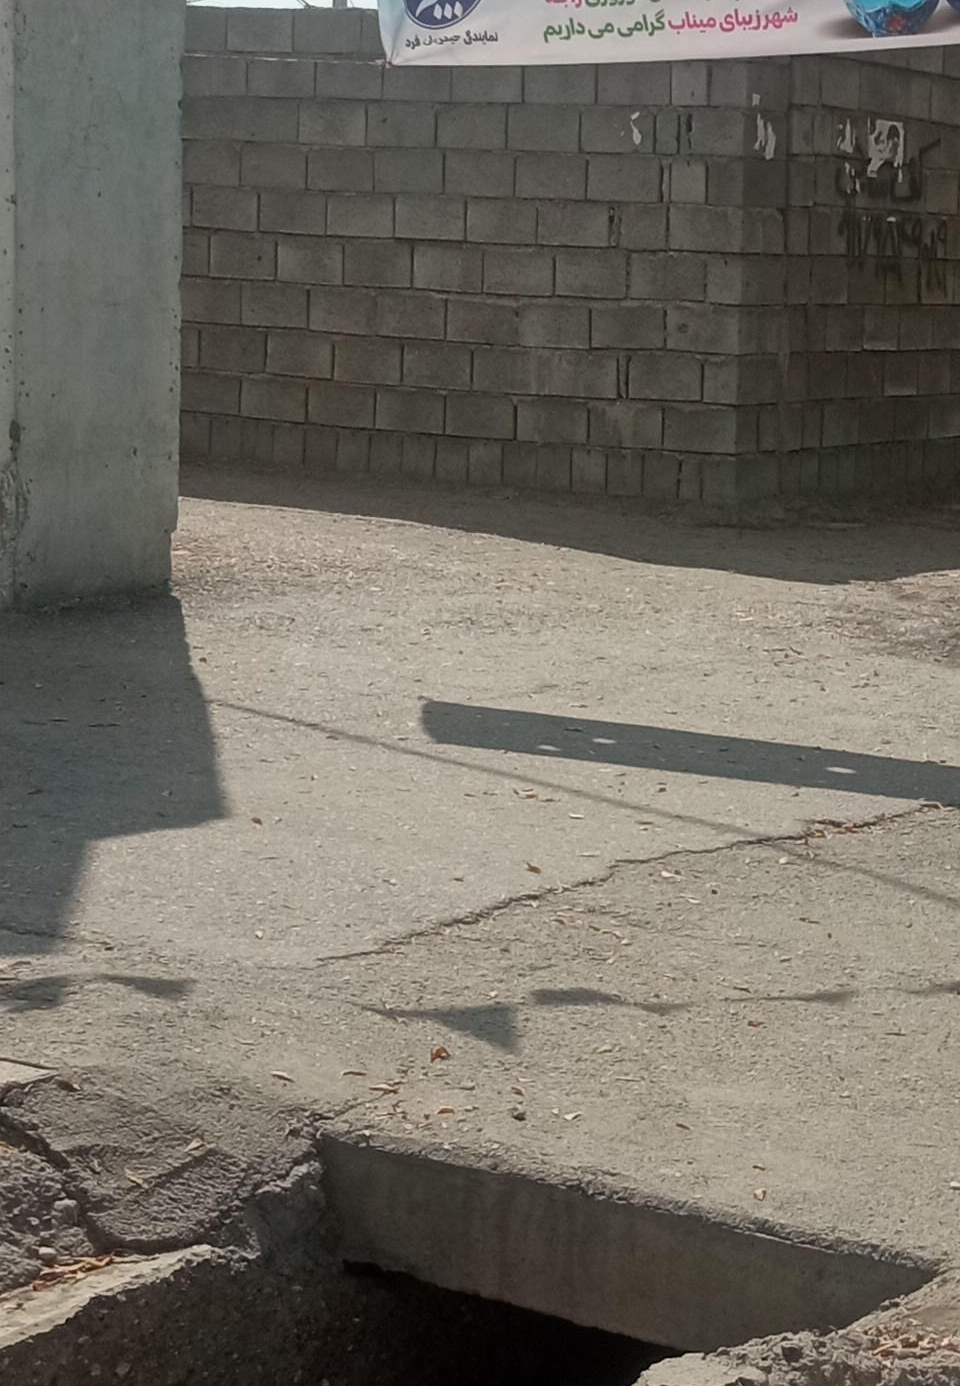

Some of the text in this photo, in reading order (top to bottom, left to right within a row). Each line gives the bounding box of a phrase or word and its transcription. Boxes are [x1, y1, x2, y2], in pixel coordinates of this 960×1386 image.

[542, 6, 799, 43] شهر زیبای میناب گرامی می داریم
[404, 33, 421, 50] فرد
[463, 29, 499, 46] نمایندگی
